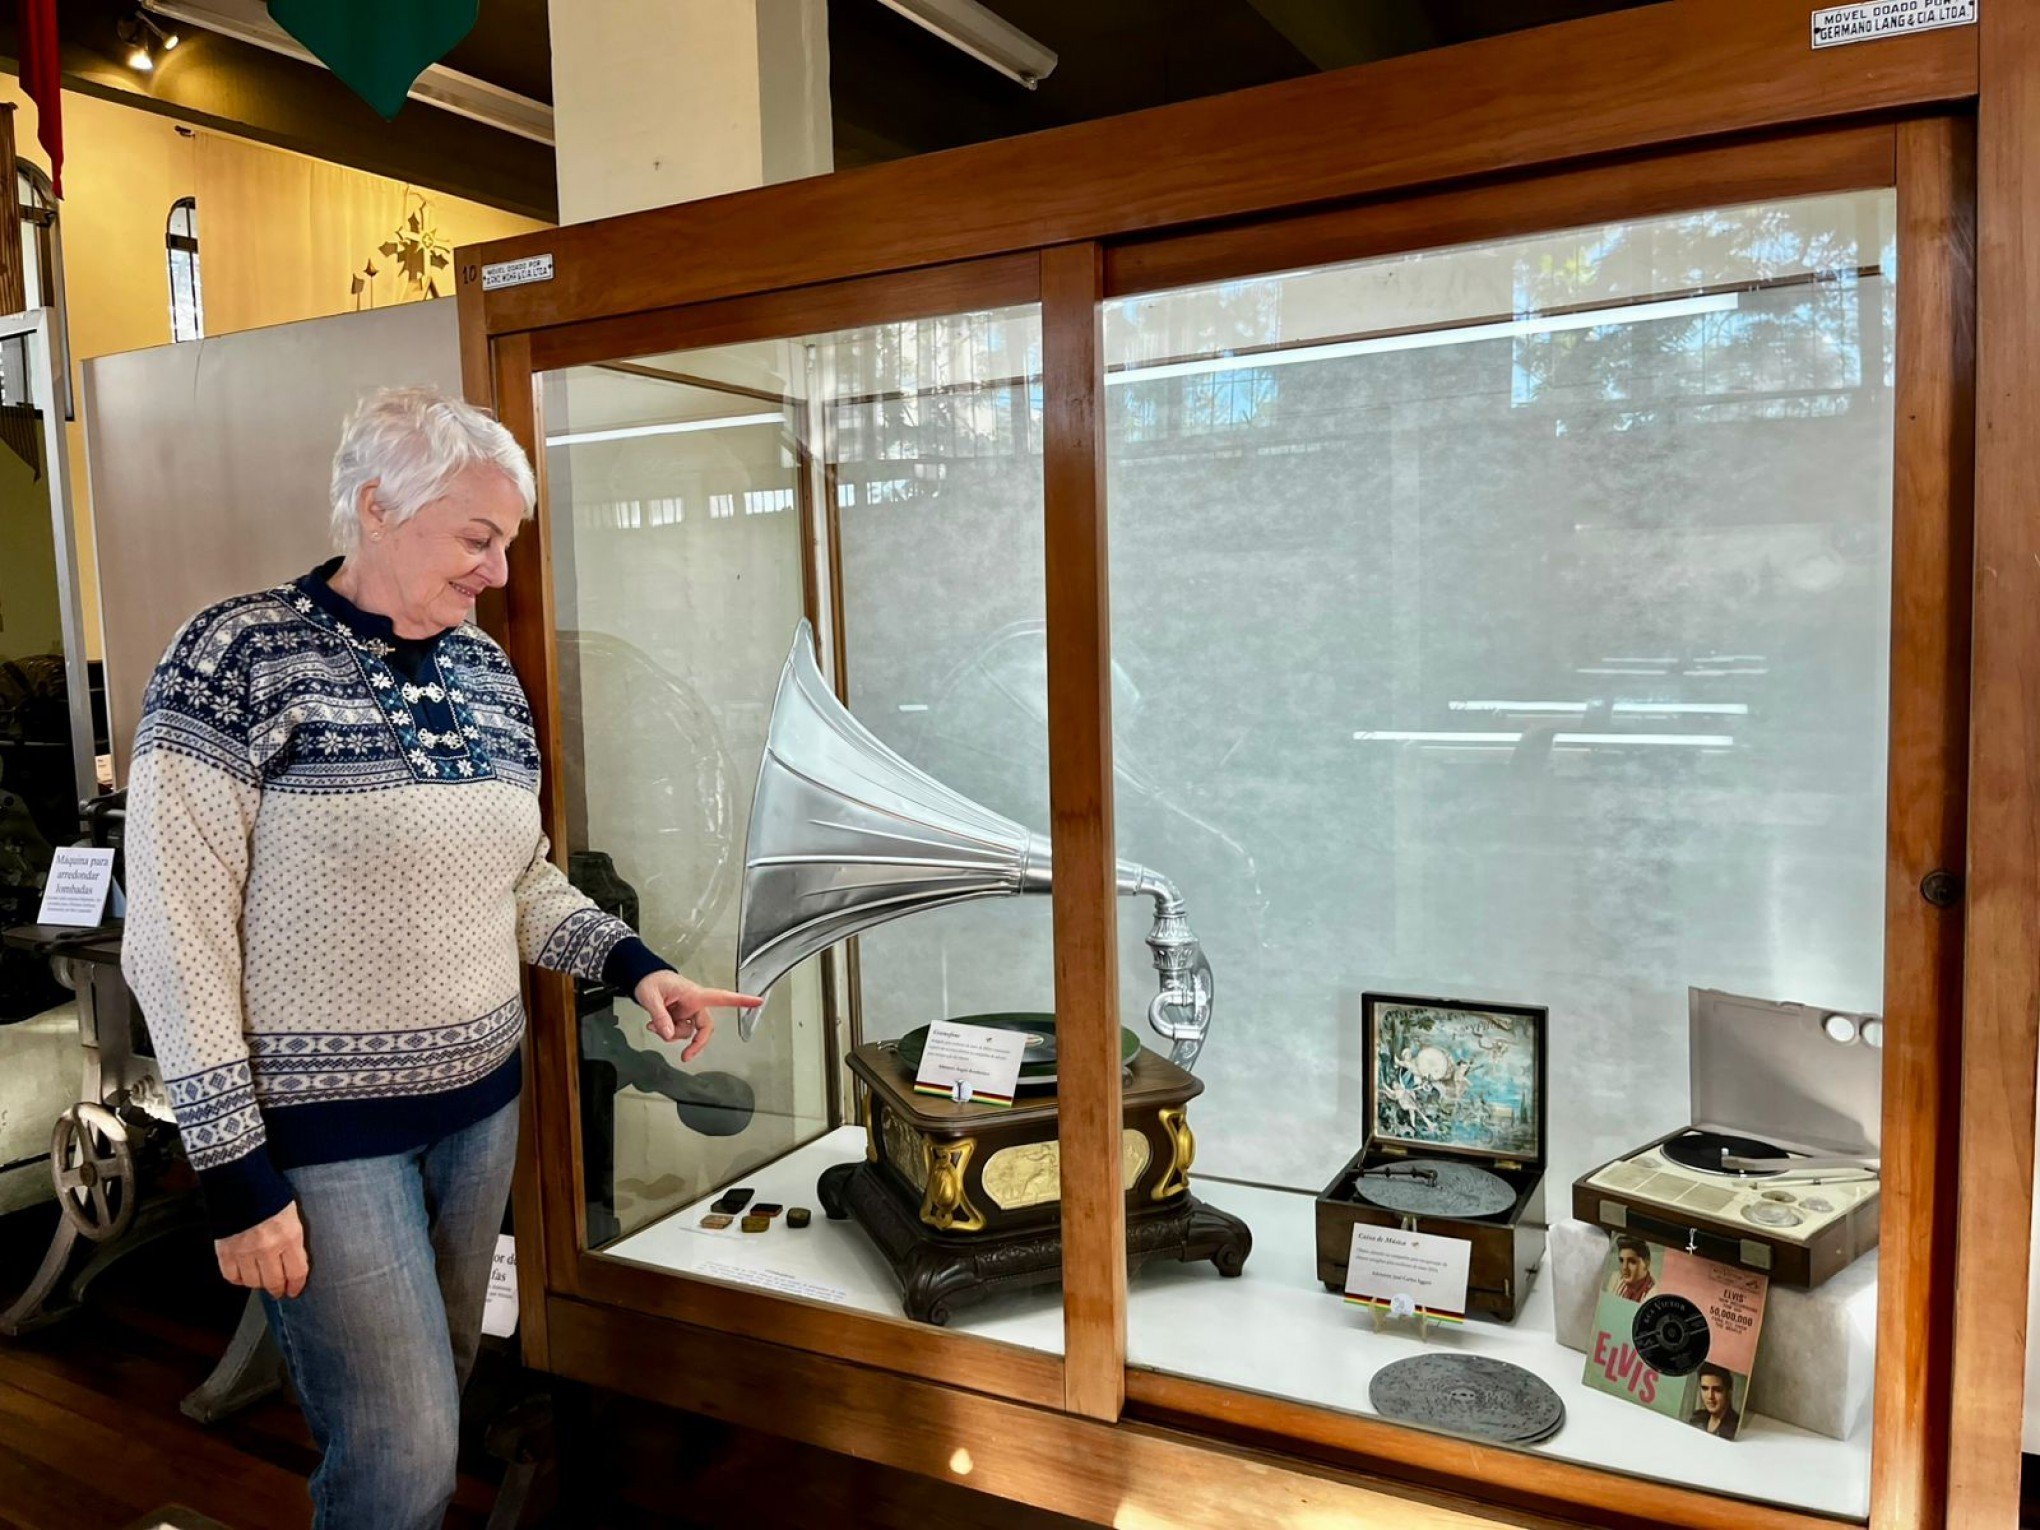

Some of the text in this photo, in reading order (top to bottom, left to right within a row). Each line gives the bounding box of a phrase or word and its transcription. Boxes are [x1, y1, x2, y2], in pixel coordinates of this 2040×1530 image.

[1872, 1, 1917, 17] DOADO
[1820, 20, 1872, 40] GERMANO
[1875, 14, 1905, 31] LANG
[1907, 13, 1914, 26] &
[463, 265, 477, 284] 10
[1593, 1331, 1660, 1404] ELVIS
